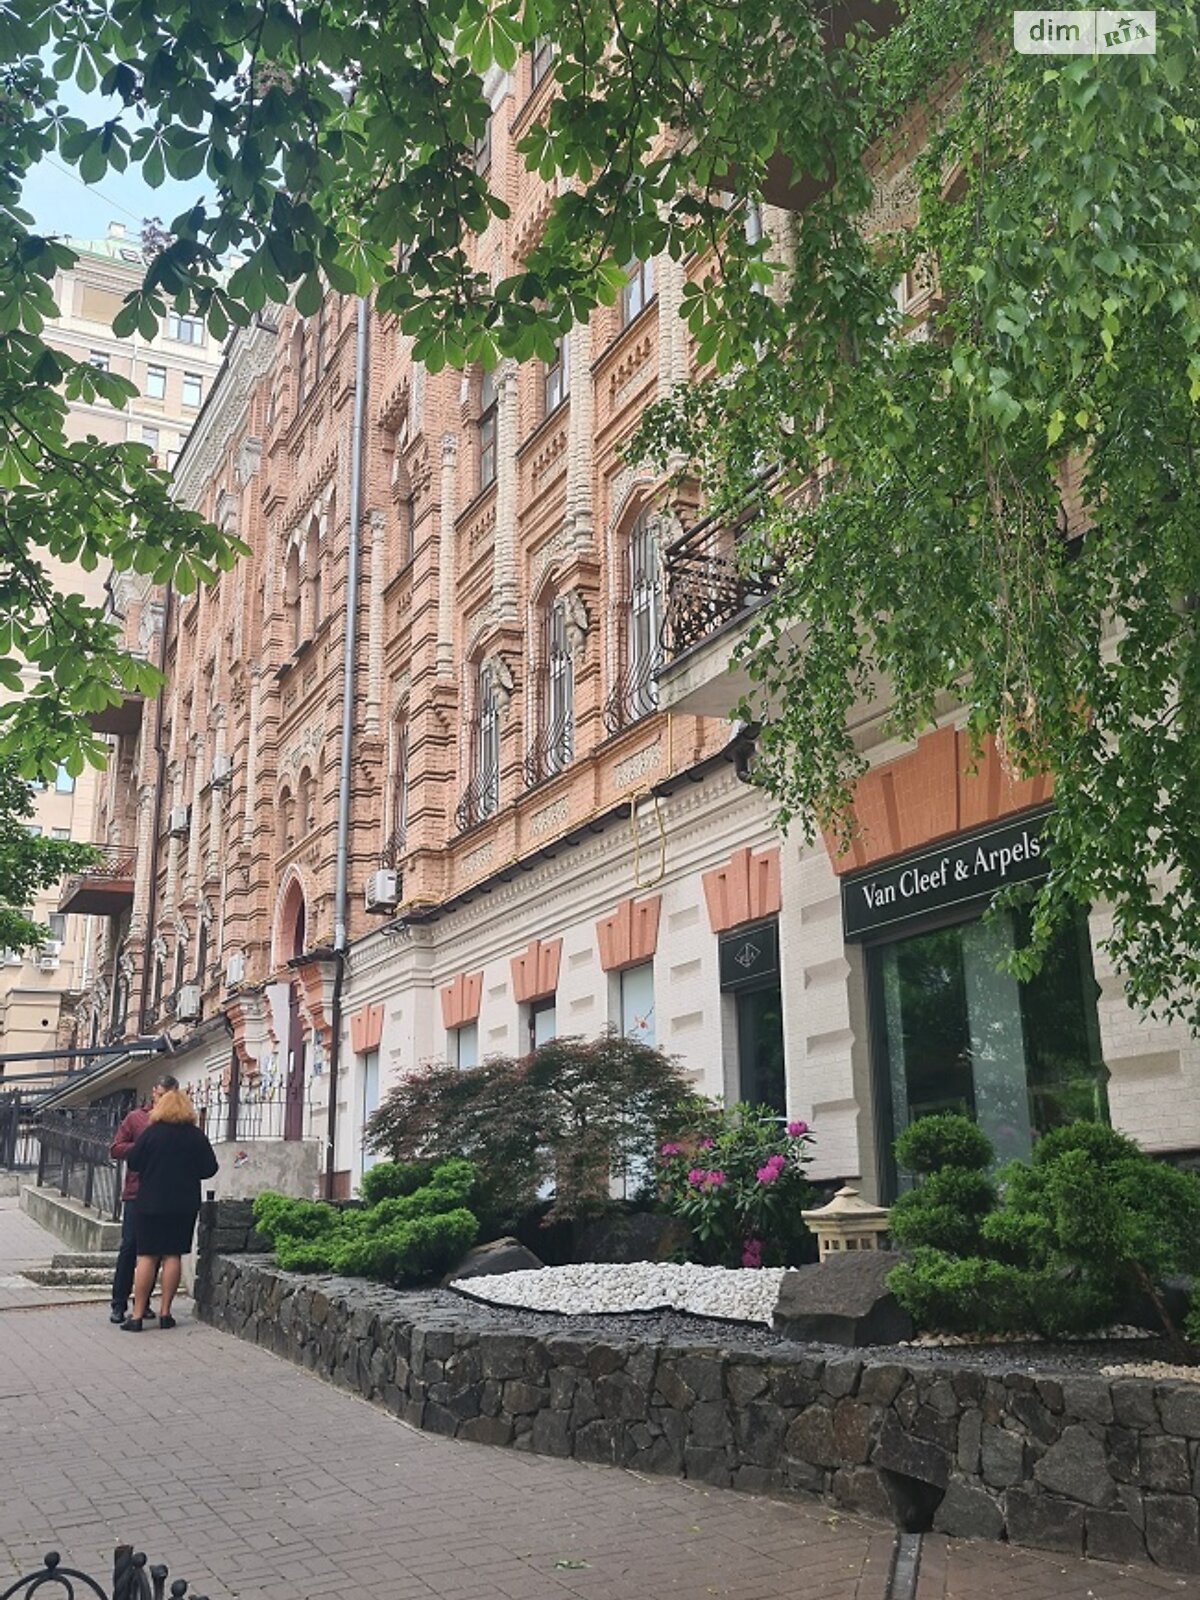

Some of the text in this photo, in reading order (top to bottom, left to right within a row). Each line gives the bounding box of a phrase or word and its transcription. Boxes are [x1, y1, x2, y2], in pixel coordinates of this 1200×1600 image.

[862, 832, 1041, 910] Van Cleef & Arpels
